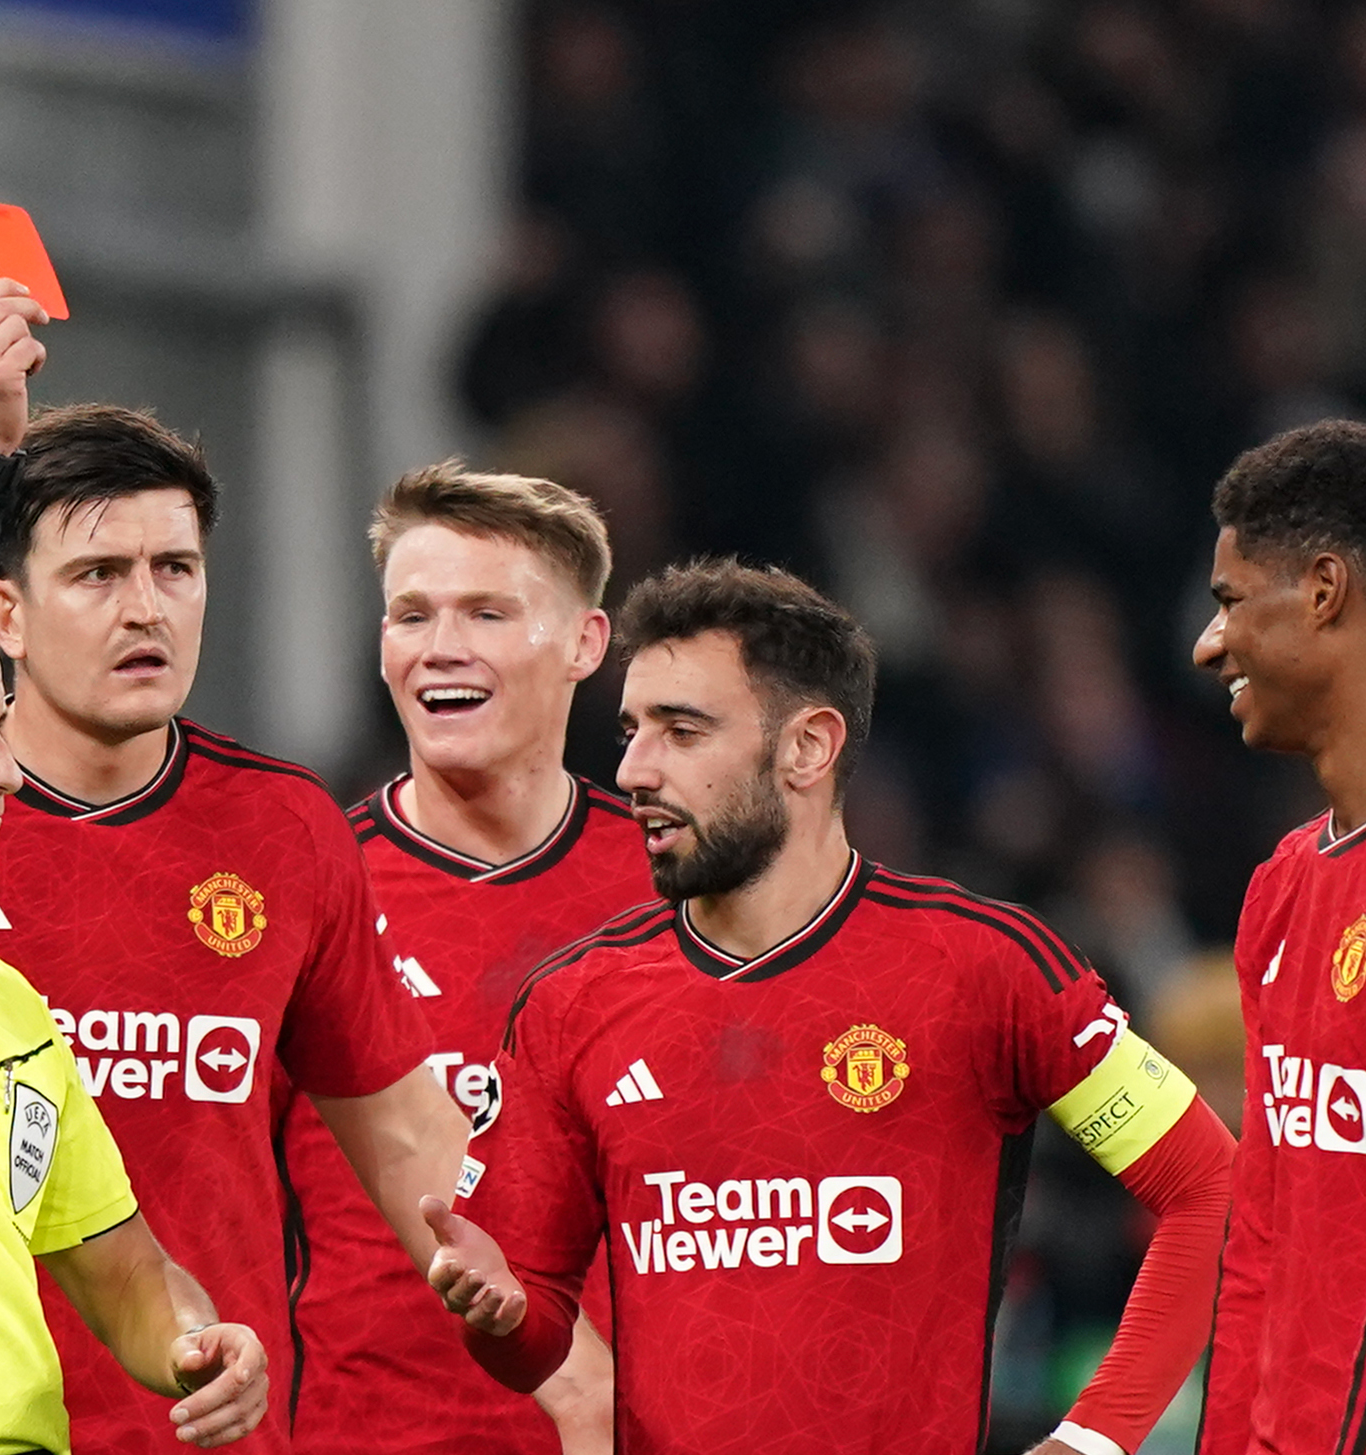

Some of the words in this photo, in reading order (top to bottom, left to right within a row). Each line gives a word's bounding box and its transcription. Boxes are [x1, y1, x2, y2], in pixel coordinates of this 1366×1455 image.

[196, 879, 258, 908] MANCHESTER
[207, 935, 251, 952] UNITED
[37, 996, 180, 1053] eam
[830, 1031, 900, 1061] MANCHESTER
[842, 1090, 892, 1107] UNITED
[25, 1105, 52, 1136] UEFA
[20, 1138, 45, 1164] MATCH
[14, 1155, 42, 1183] OFFICIAL
[643, 1170, 813, 1225] Team
[621, 1219, 813, 1275] Viewer
